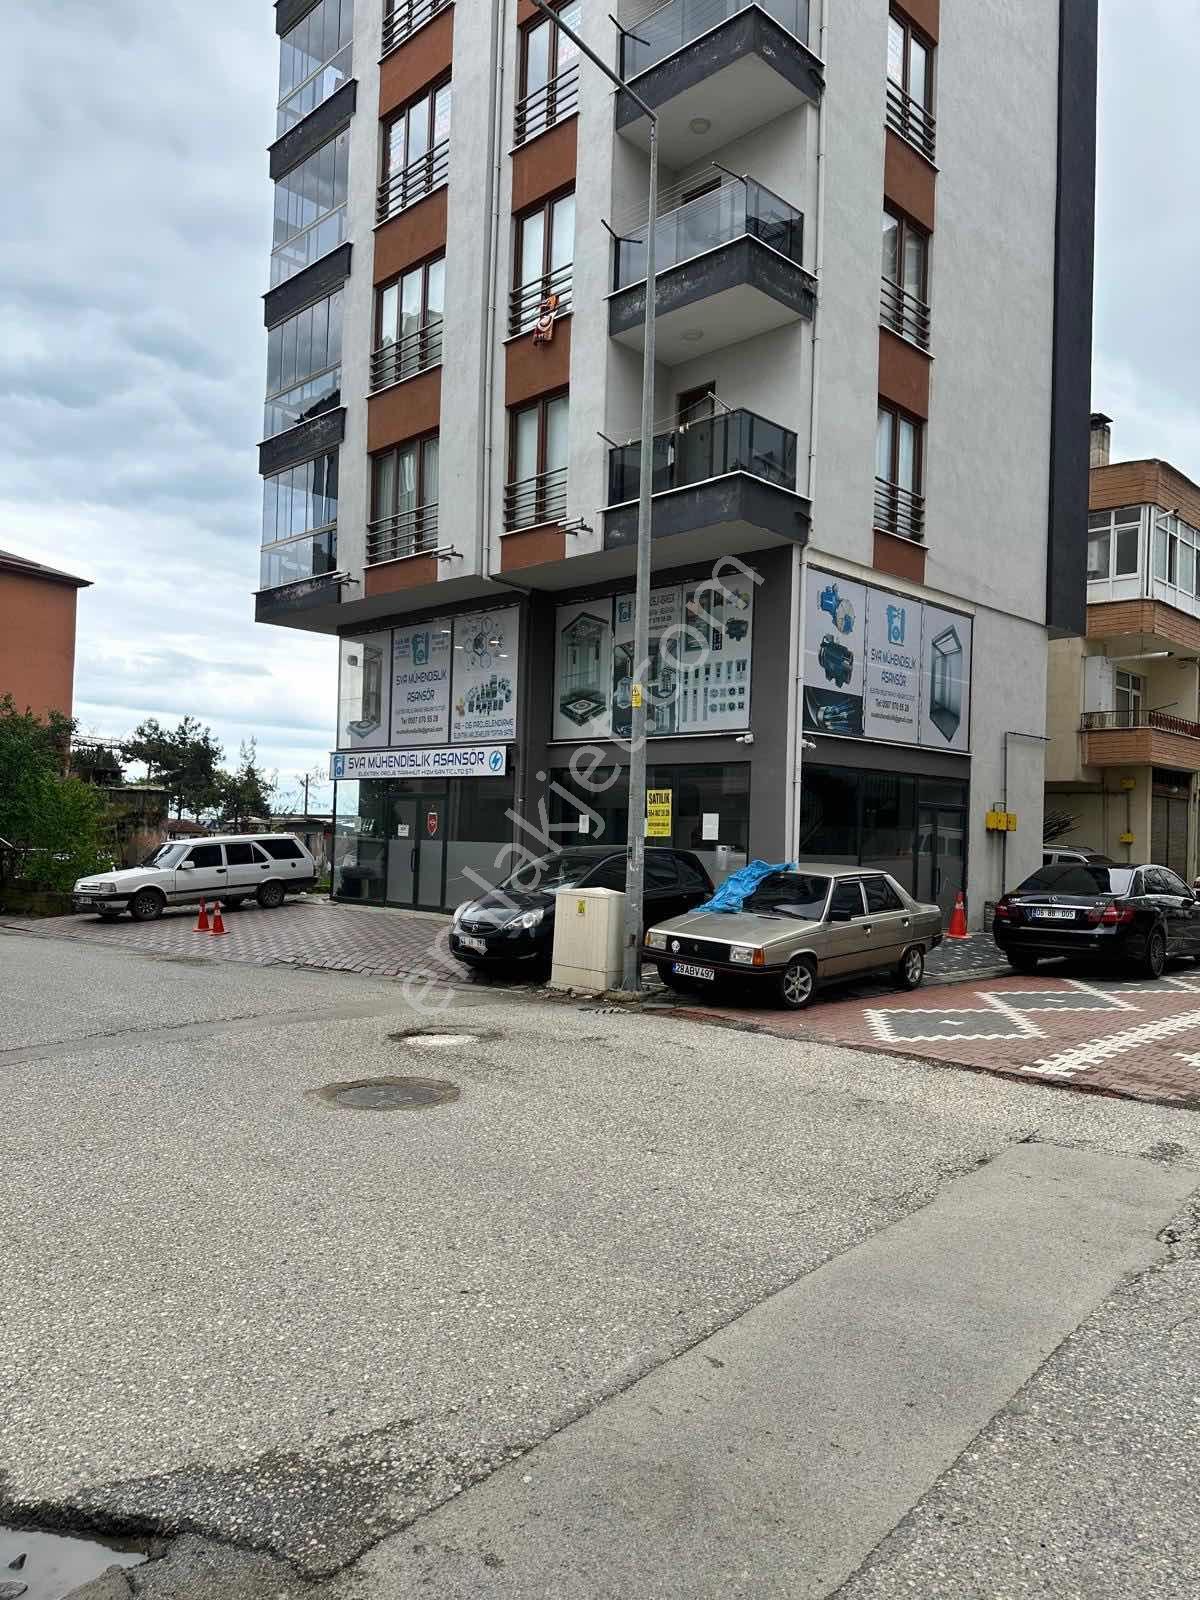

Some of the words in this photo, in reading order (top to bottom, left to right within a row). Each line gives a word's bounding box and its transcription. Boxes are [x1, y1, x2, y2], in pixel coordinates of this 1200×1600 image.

[348, 756, 366, 769] SVA
[368, 751, 431, 769] MÜHENDİSLİK
[433, 747, 485, 766] ASANSÖR
[649, 793, 670, 804] SATILIK
